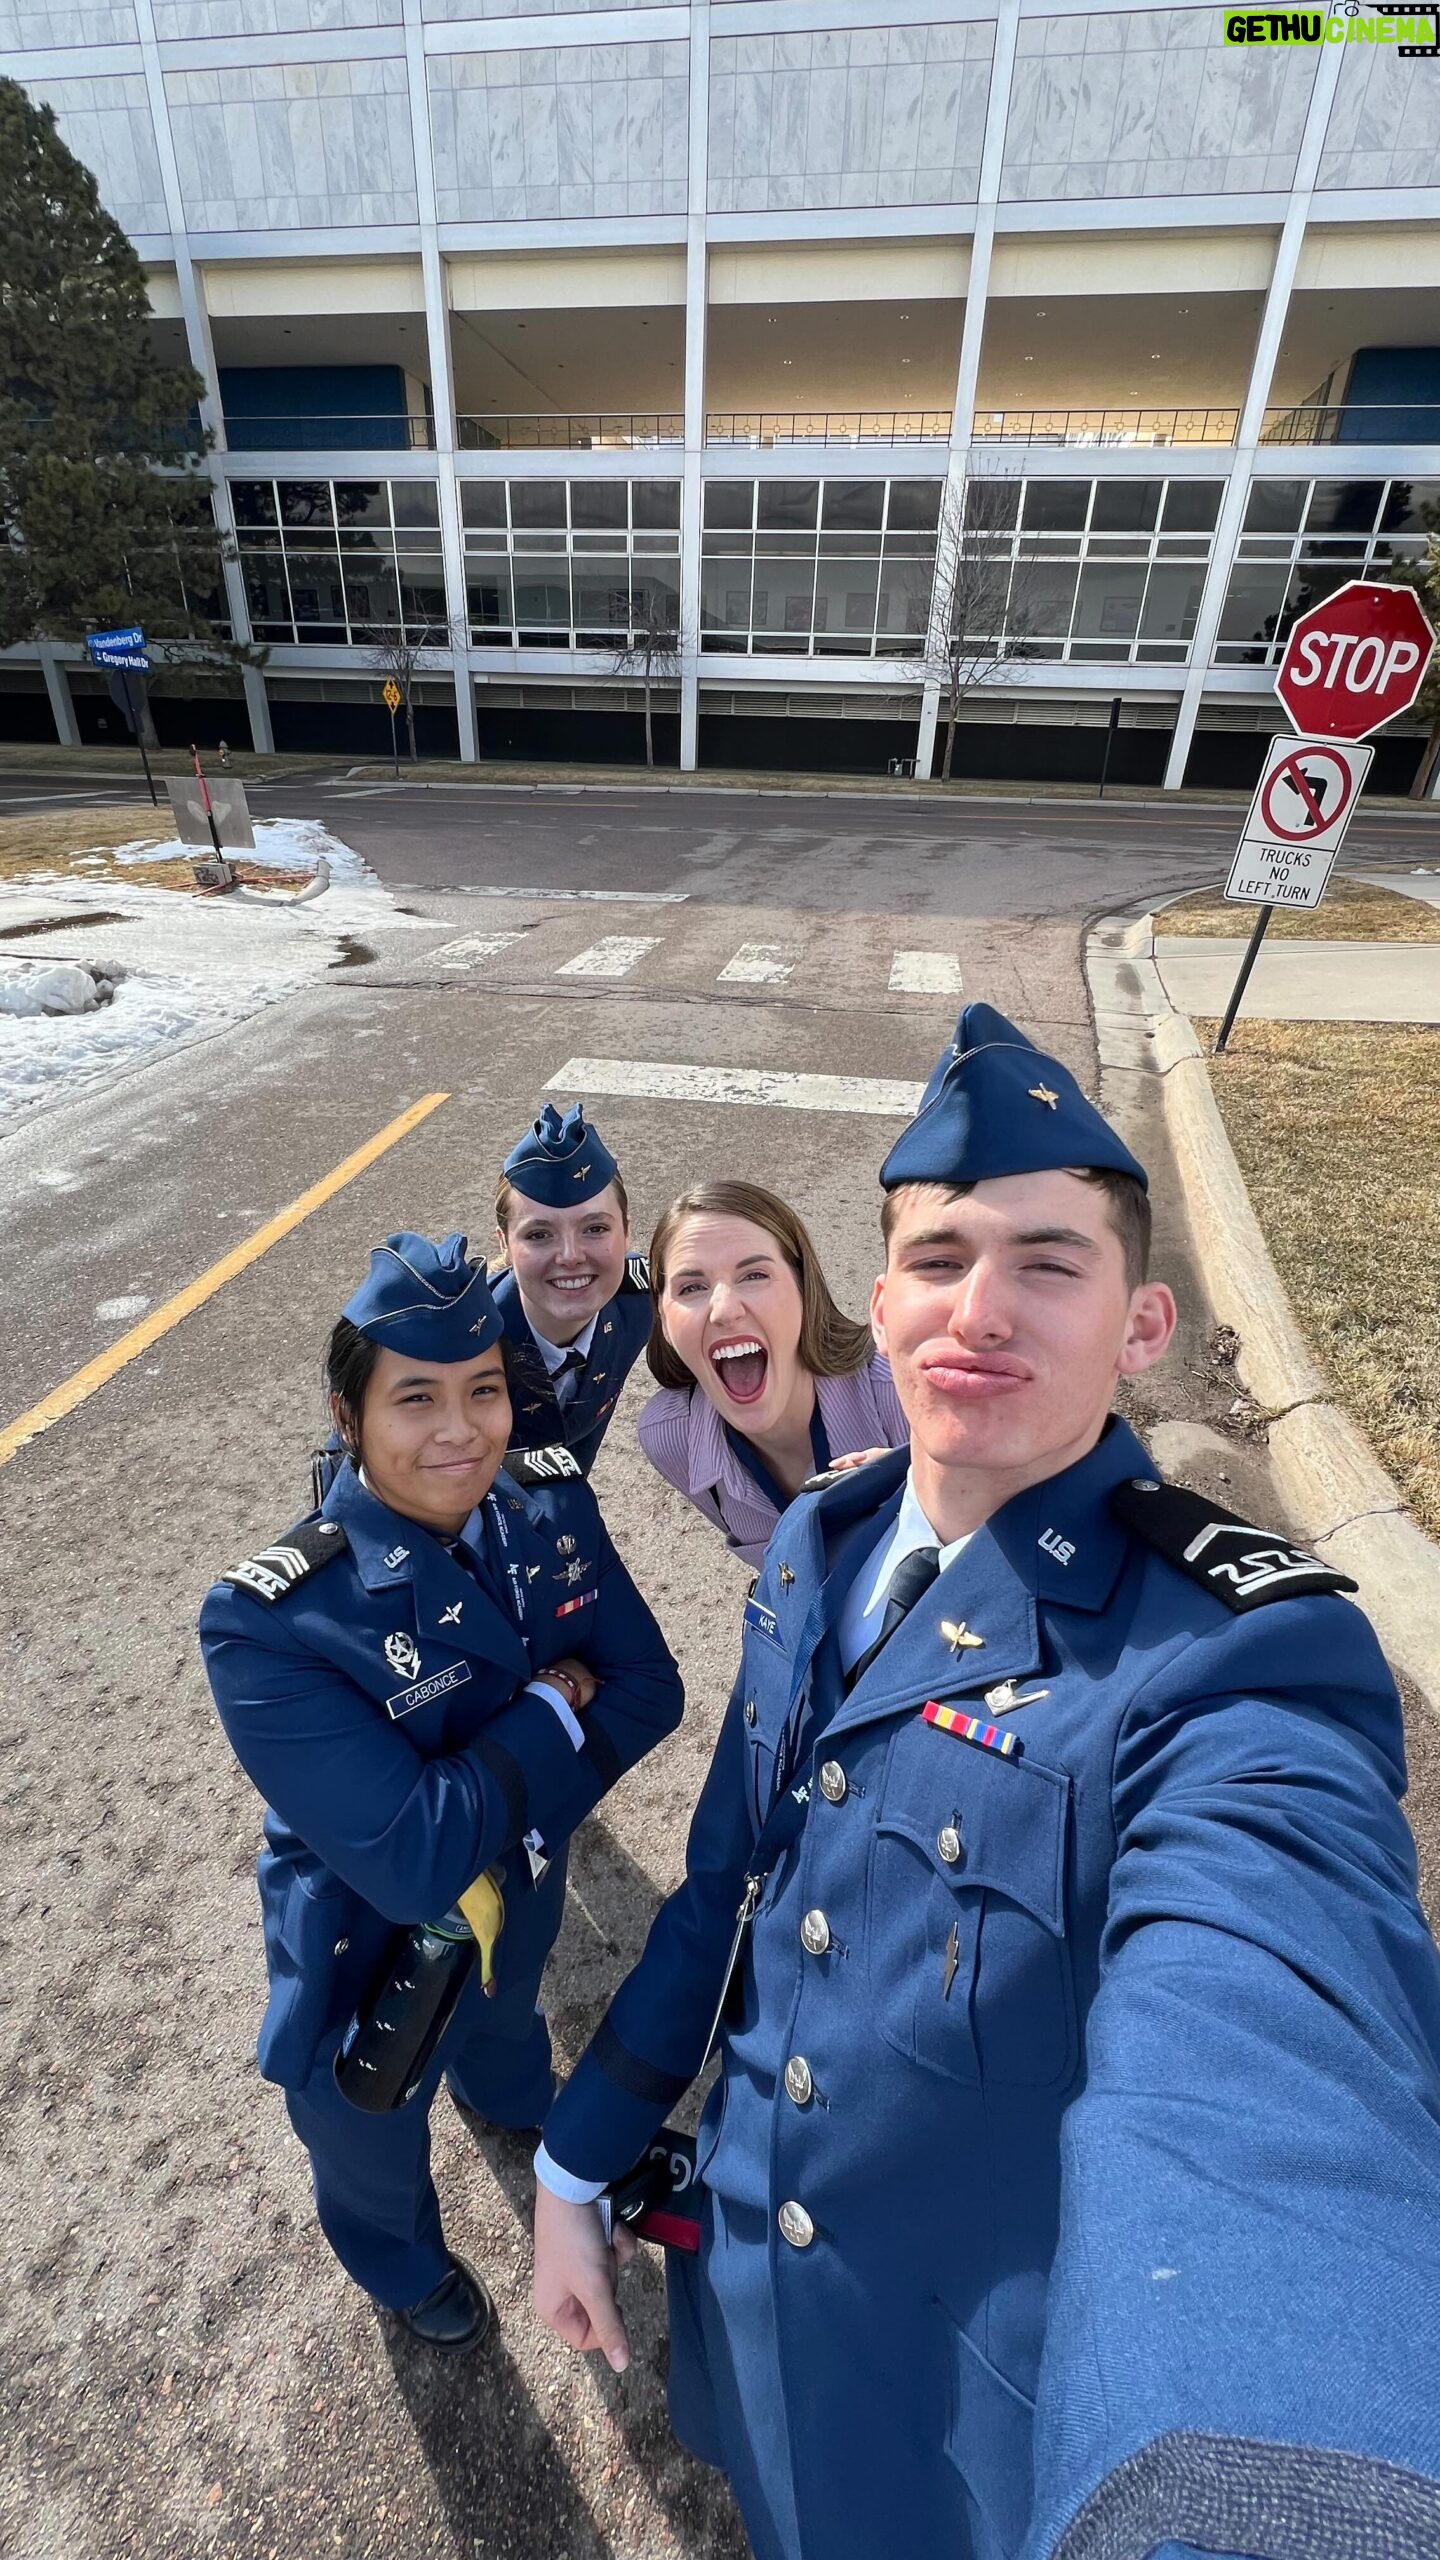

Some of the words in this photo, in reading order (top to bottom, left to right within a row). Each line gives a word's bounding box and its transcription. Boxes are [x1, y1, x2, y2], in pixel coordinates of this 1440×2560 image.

[94, 634, 134, 648] Vandenberg
[133, 632, 142, 643] Dr
[102, 652, 129, 667] Gregory
[128, 656, 141, 667] Hall
[141, 657, 149, 668] Dr
[1289, 630, 1420, 695] STOP
[1259, 847, 1312, 868] TRUCKS
[1269, 866, 1289, 881] NO
[1238, 879, 1271, 897] LEFT
[1276, 884, 1311, 901] TURN
[758, 1613, 776, 1635] KAYE
[405, 1670, 459, 1706] CABONCE
